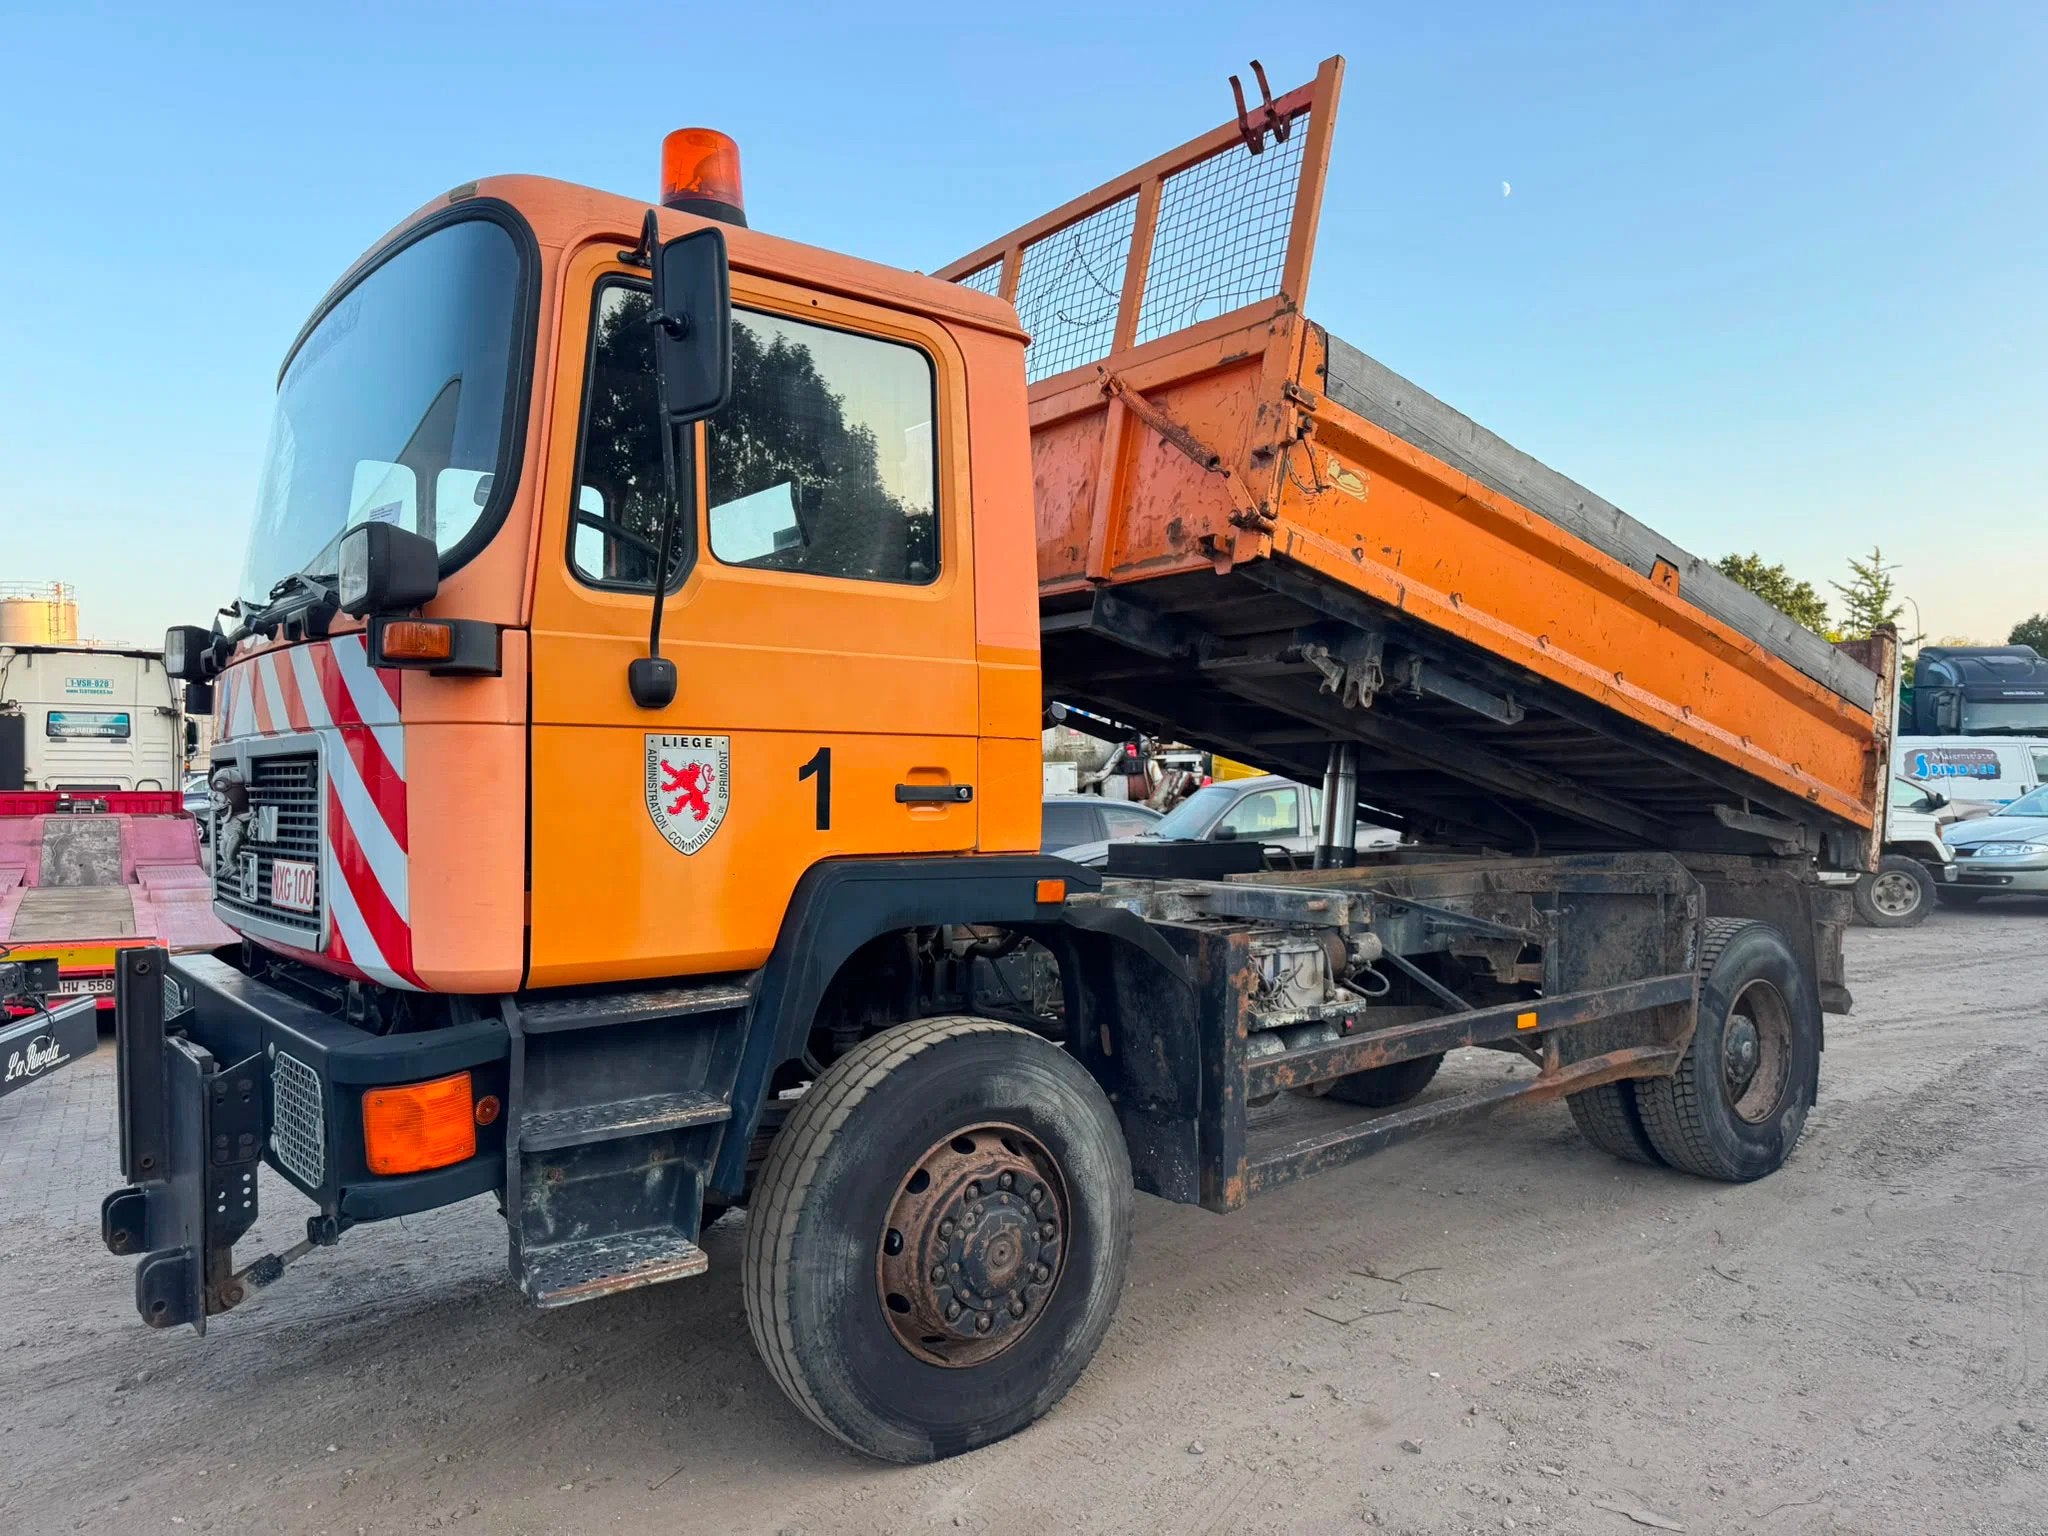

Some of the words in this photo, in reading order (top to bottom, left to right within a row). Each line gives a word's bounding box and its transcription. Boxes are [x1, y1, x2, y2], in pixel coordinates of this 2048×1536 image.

[662, 736, 713, 748] LIEGE
[647, 749, 669, 829] ADMINISTRATION
[668, 816, 720, 852] COMMUNALE
[718, 750, 728, 800] SPRIMONT
[799, 747, 831, 830] 1
[58, 980, 114, 994] HW-558
[5, 1051, 26, 1082] La
[25, 1036, 60, 1077] Rueda
